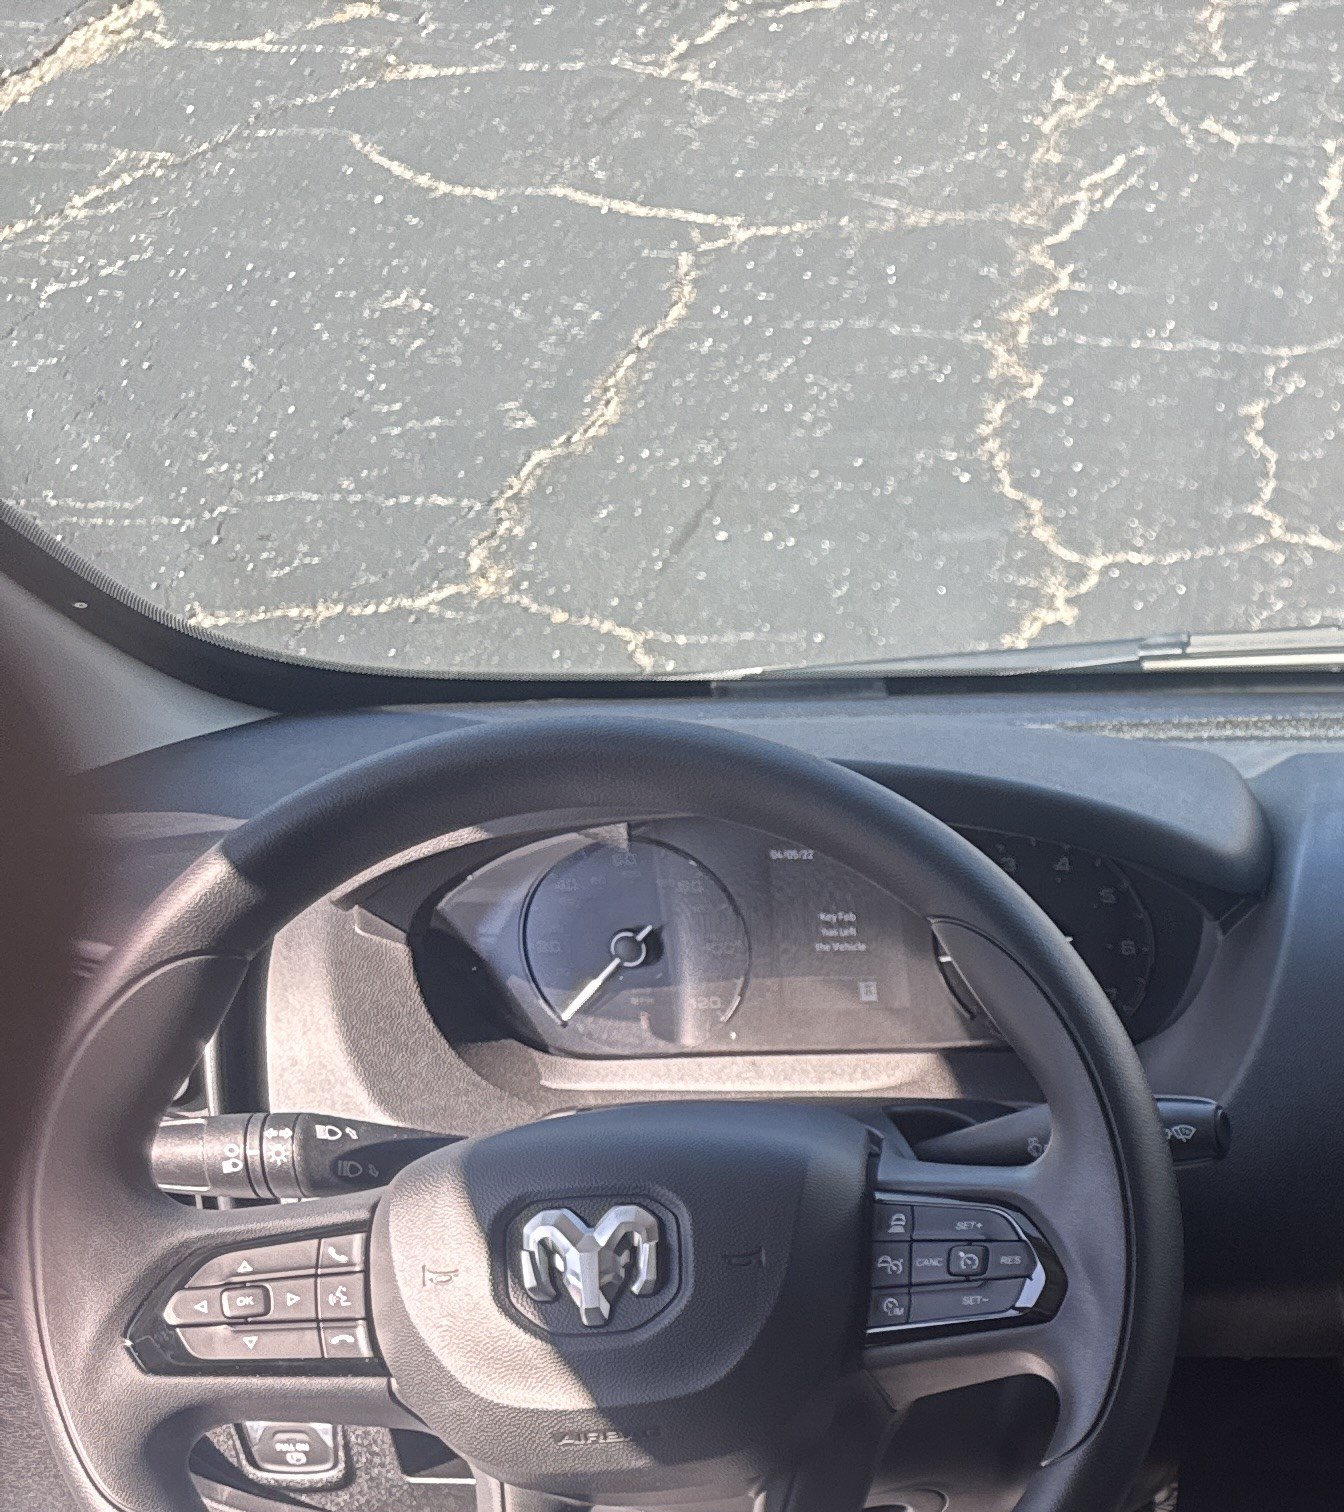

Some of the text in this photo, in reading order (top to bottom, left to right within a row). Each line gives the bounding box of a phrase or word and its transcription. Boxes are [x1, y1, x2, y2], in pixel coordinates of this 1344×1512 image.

[916, 1257, 944, 1267] CANC
[1001, 1255, 1022, 1265] RES
[236, 1296, 255, 1307] OK
